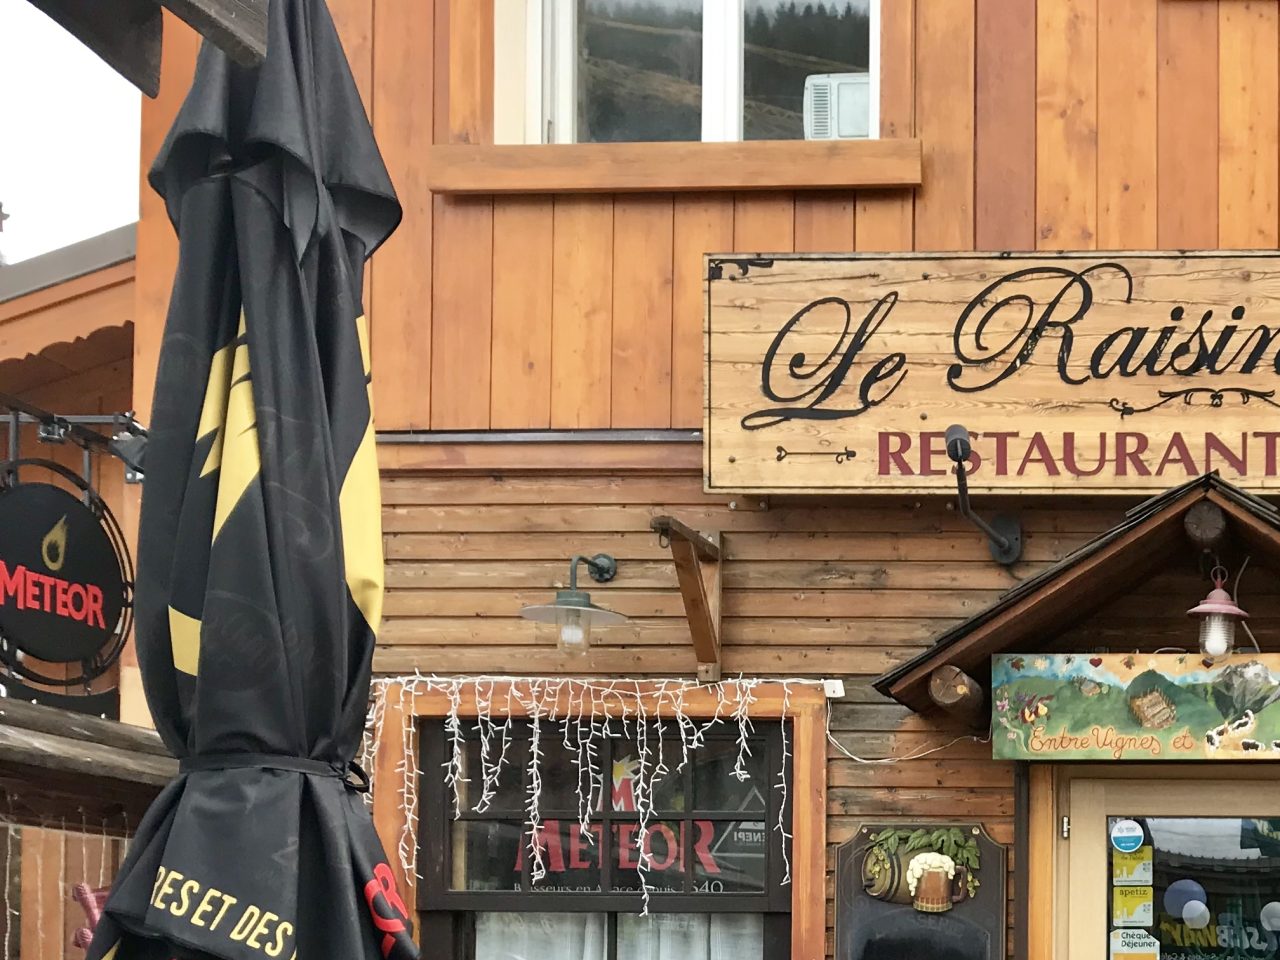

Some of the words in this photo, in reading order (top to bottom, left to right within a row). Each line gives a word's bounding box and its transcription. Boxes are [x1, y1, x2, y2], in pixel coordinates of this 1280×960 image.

[741, 291, 908, 430] Le
[0, 559, 106, 630] METEOR
[1030, 726, 1091, 751] Entre
[1091, 726, 1162, 759] Vignes
[1172, 729, 1194, 749] et
[513, 819, 722, 873] METEOR
[1119, 888, 1148, 898] apetiz
[190, 887, 238, 931] ET
[229, 904, 294, 957] DES
[1121, 931, 1151, 940] Chèque
[1121, 940, 1157, 949] Déjeuner
